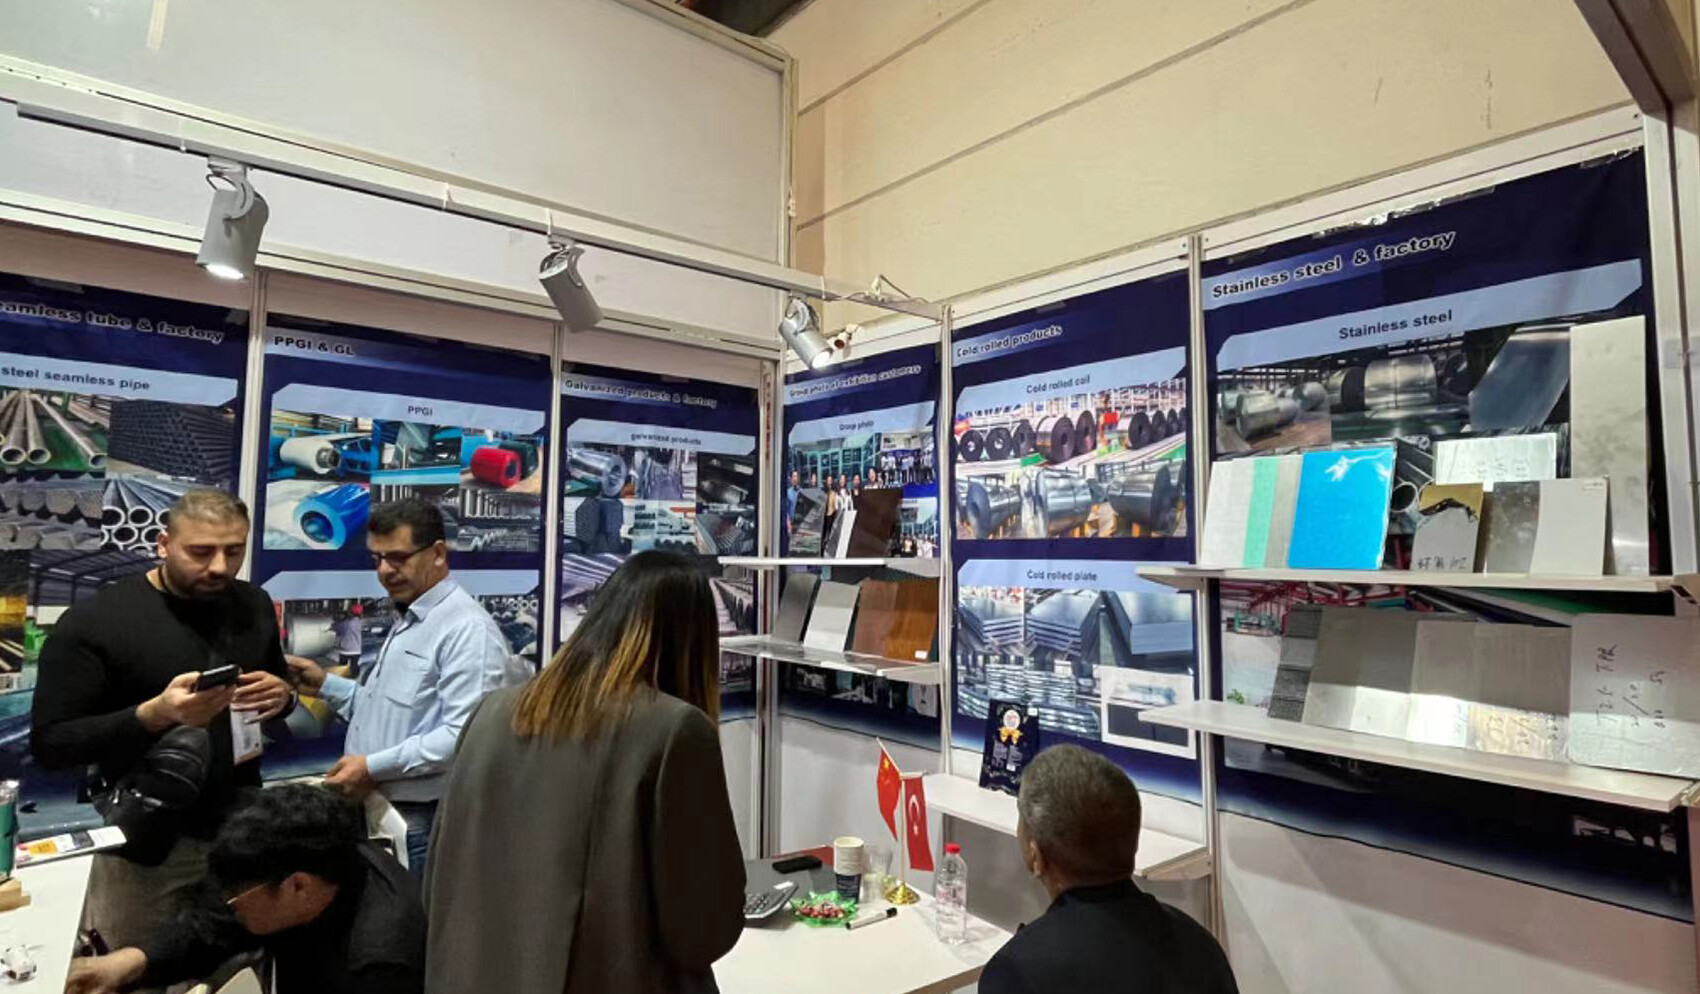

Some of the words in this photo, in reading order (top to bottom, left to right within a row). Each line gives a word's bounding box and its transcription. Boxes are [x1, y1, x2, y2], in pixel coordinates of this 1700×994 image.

[1213, 270, 1289, 298] Stainless
[1295, 255, 1342, 279] steel
[1353, 250, 1368, 265] &
[1375, 231, 1456, 261] factory
[0, 301, 82, 323] amless
[85, 311, 132, 330] tube
[136, 318, 153, 332] &
[157, 321, 224, 345] factory
[1339, 318, 1408, 339] Stainless
[1413, 310, 1452, 328] steel
[274, 336, 312, 350] PPGI
[318, 342, 329, 352] &
[334, 344, 355, 356] GL
[957, 346, 978, 357] Cold
[980, 335, 1010, 352] rolled
[1012, 324, 1063, 348] products
[1, 366, 40, 378] steel
[44, 371, 115, 386] seamless
[120, 379, 150, 391] pipe
[1026, 383, 1047, 393] Cold
[1049, 378, 1073, 389] rolled
[1075, 374, 1090, 386] coil
[408, 405, 433, 416] PPGI
[1026, 569, 1045, 579] Cold
[1047, 571, 1073, 581] rolled
[1074, 571, 1097, 581] plate
